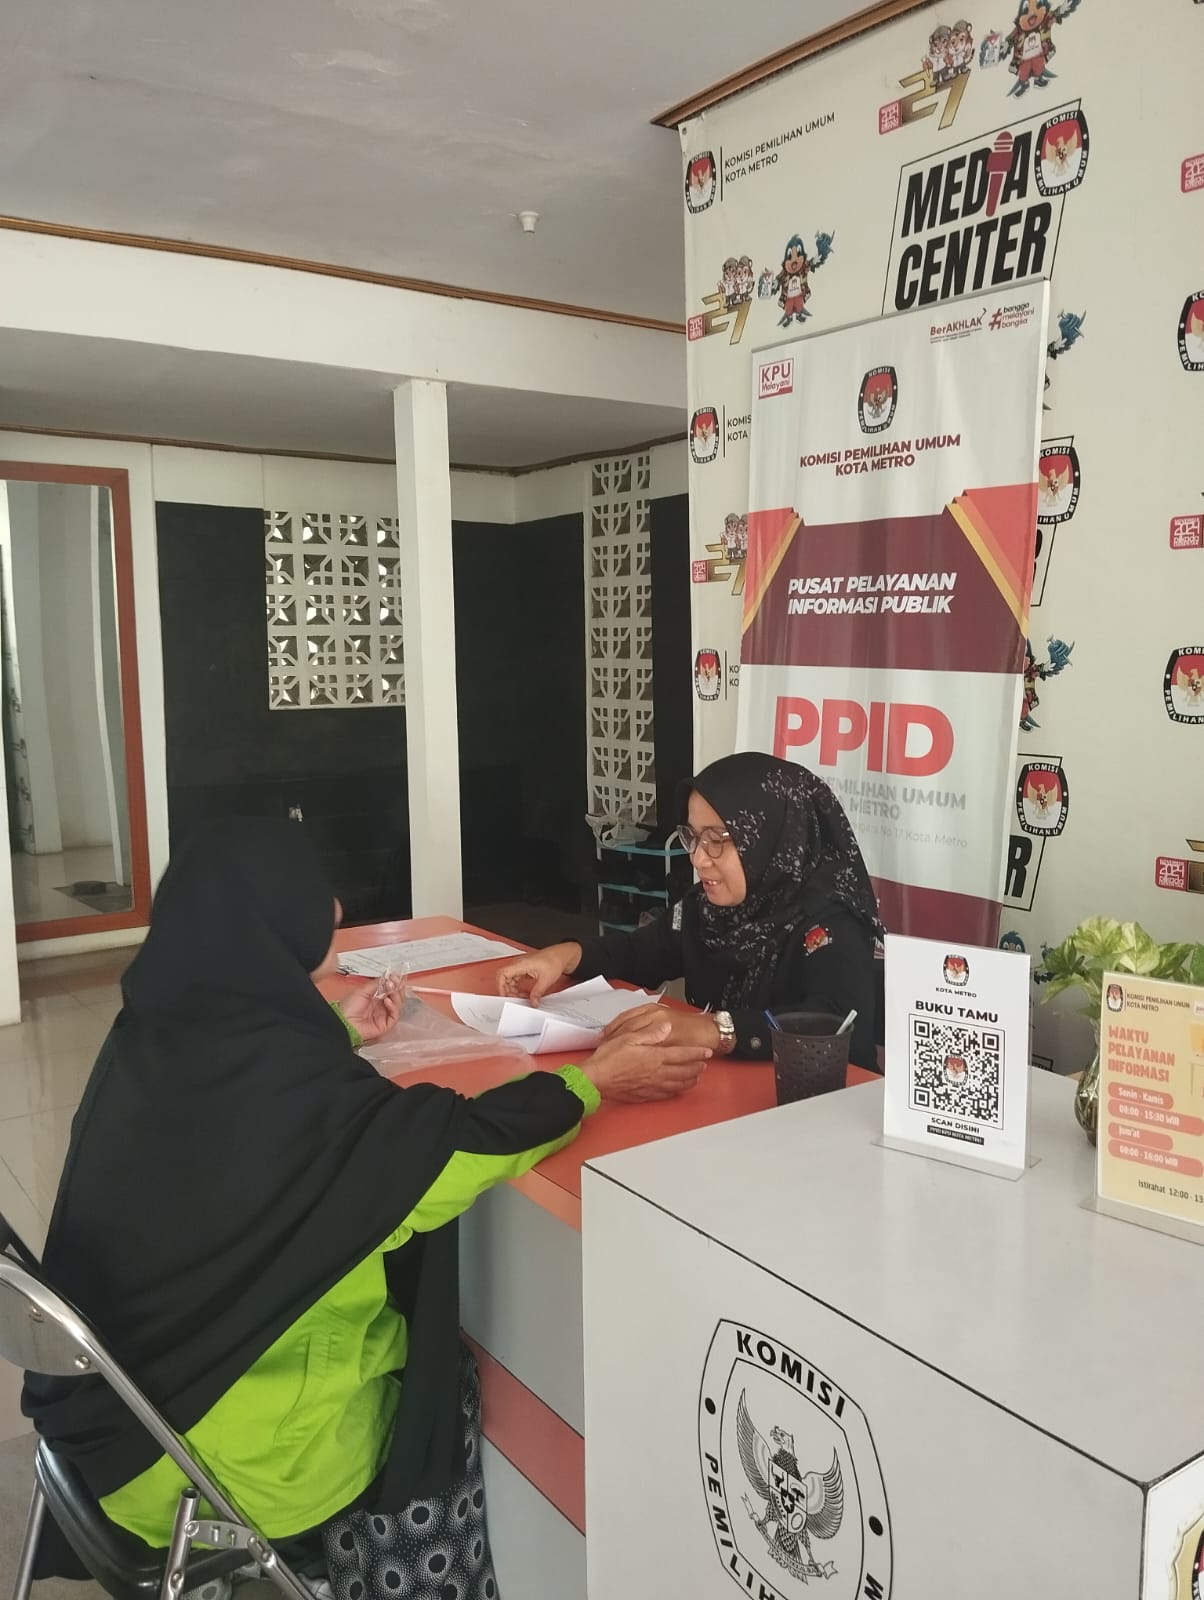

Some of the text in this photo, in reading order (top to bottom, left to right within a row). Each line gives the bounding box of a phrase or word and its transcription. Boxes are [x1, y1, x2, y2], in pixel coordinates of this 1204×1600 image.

[1046, 111, 1079, 128] KOMISI
[725, 112, 835, 169] KOMISI PEMILIHAN UMUM
[725, 153, 779, 184] KOTA METRO
[1035, 150, 1088, 196] PEMILIHAN UMUM
[895, 202, 1052, 311] CENTER
[930, 313, 984, 336] BerAKHLAK
[1179, 339, 1204, 371] PEMILIH
[762, 362, 790, 383] KPU
[728, 415, 752, 428] KOMIS
[728, 430, 748, 442] KOTA
[800, 434, 961, 468] KOMISI PEMILIHAN UMUM
[1039, 447, 1070, 458] KOMISI
[835, 454, 915, 476] KOTA METRO
[788, 572, 957, 595] PUSAT PELAYANAN
[787, 595, 954, 615] INFORMASI PUBLIK
[1178, 647, 1204, 657] KOMI
[773, 696, 954, 777] PPID
[1028, 764, 1059, 774] KOMISI
[849, 797, 901, 820] METRO
[902, 787, 966, 810] UMUM
[934, 834, 968, 848] Metro
[954, 990, 977, 998] METRO
[1127, 1001, 1140, 1009] KOTA
[915, 1000, 998, 1023] BUKU TAMU
[1108, 1025, 1149, 1044] WAKTU
[1108, 1041, 1175, 1067] PELAYANAN
[1108, 1058, 1169, 1083] INFORMASI
[1118, 1087, 1138, 1099] Senin
[1142, 1092, 1164, 1105] Kamis
[931, 1117, 980, 1133] SCAN DISINI
[1138, 1179, 1166, 1194] Istirahat
[1169, 1187, 1189, 1200] 12:00
[736, 1329, 846, 1419] KOMISI
[704, 1452, 776, 1600] PEMILIH
